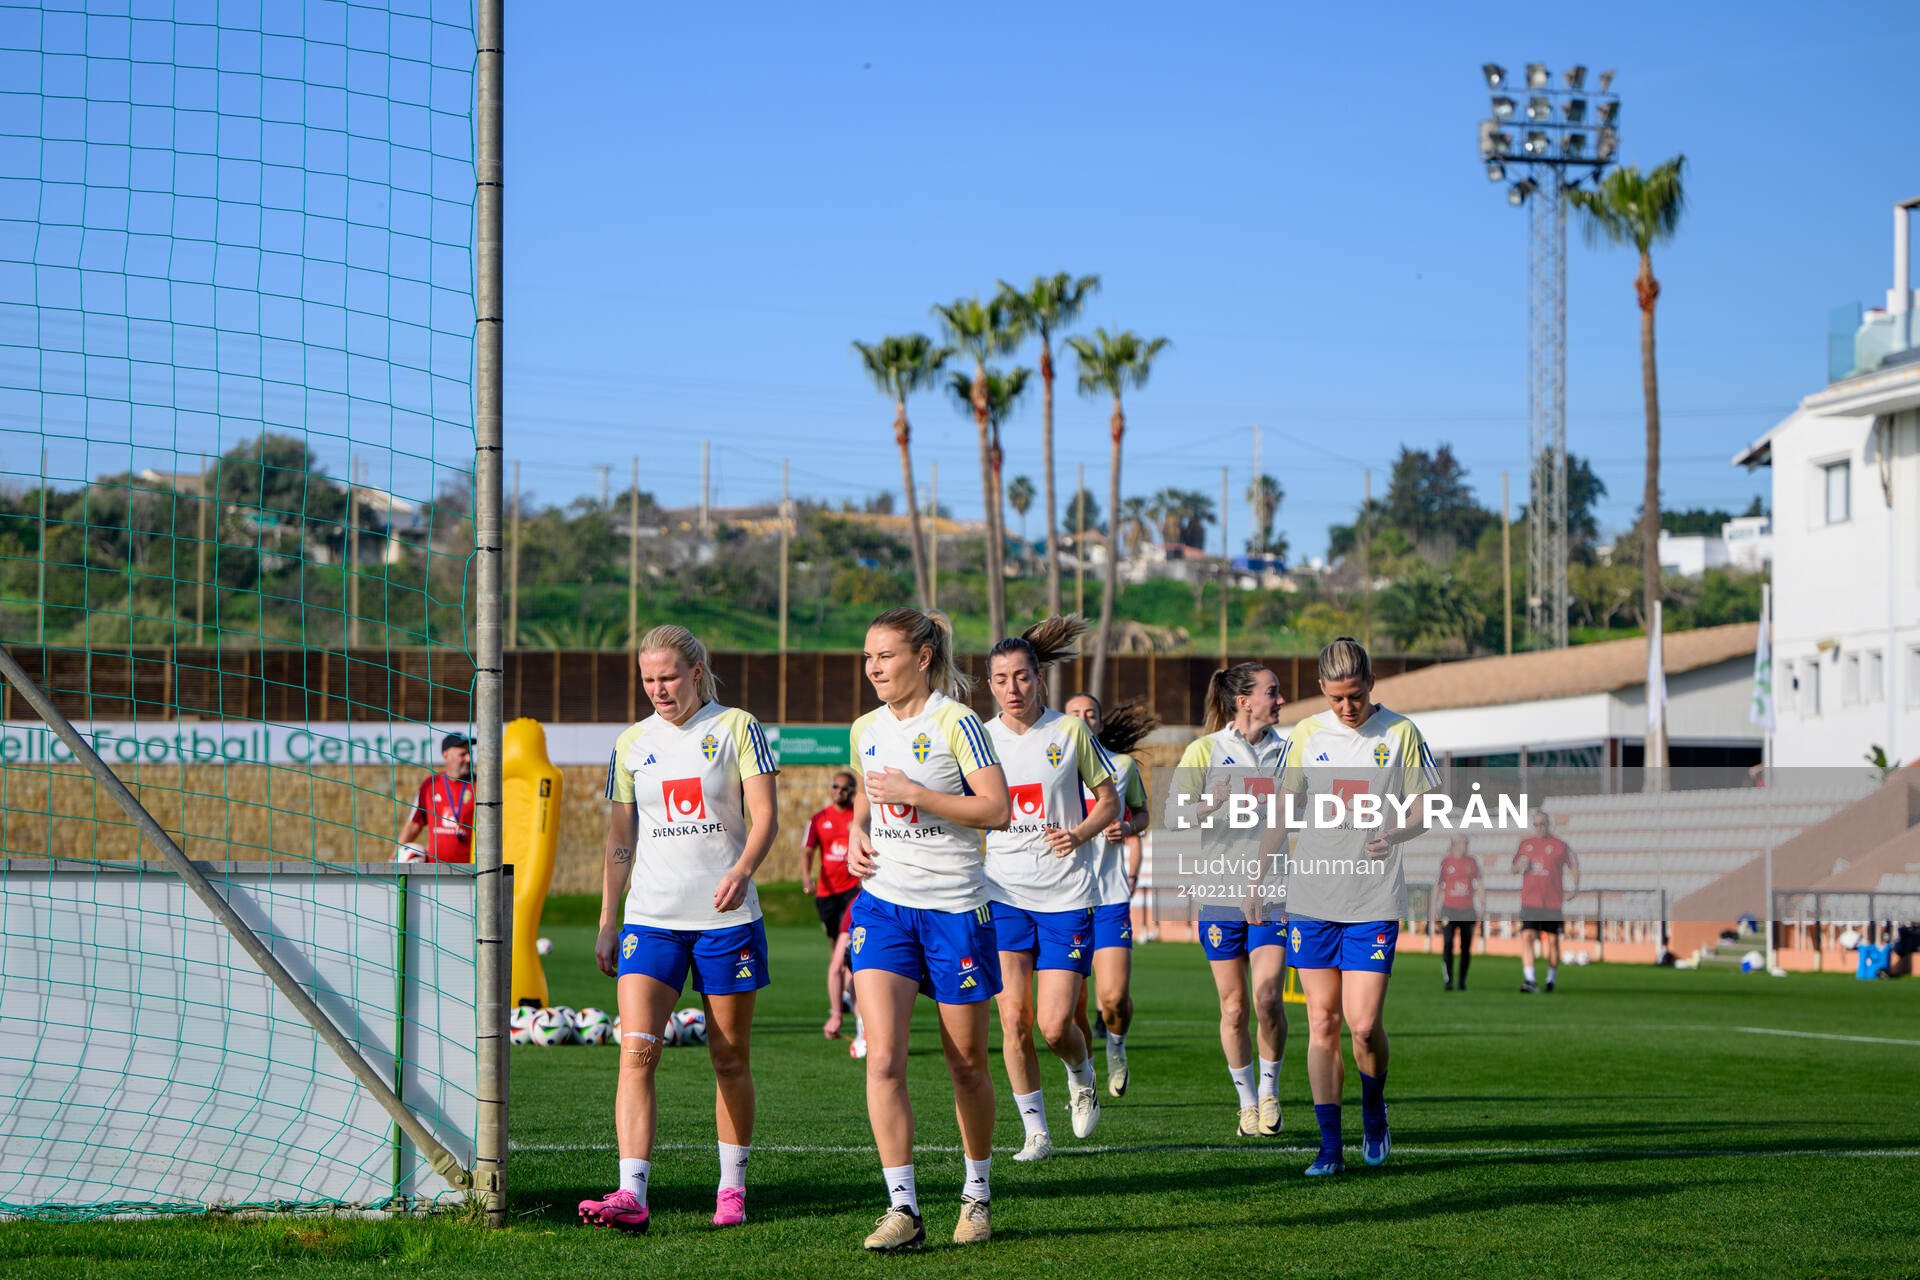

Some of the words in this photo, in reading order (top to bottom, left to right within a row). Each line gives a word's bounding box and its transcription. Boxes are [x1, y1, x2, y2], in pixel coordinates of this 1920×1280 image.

[93, 729, 270, 763] Football
[285, 729, 435, 763] Center
[652, 825, 699, 838] SVENSKA
[915, 826, 945, 839] SPEL
